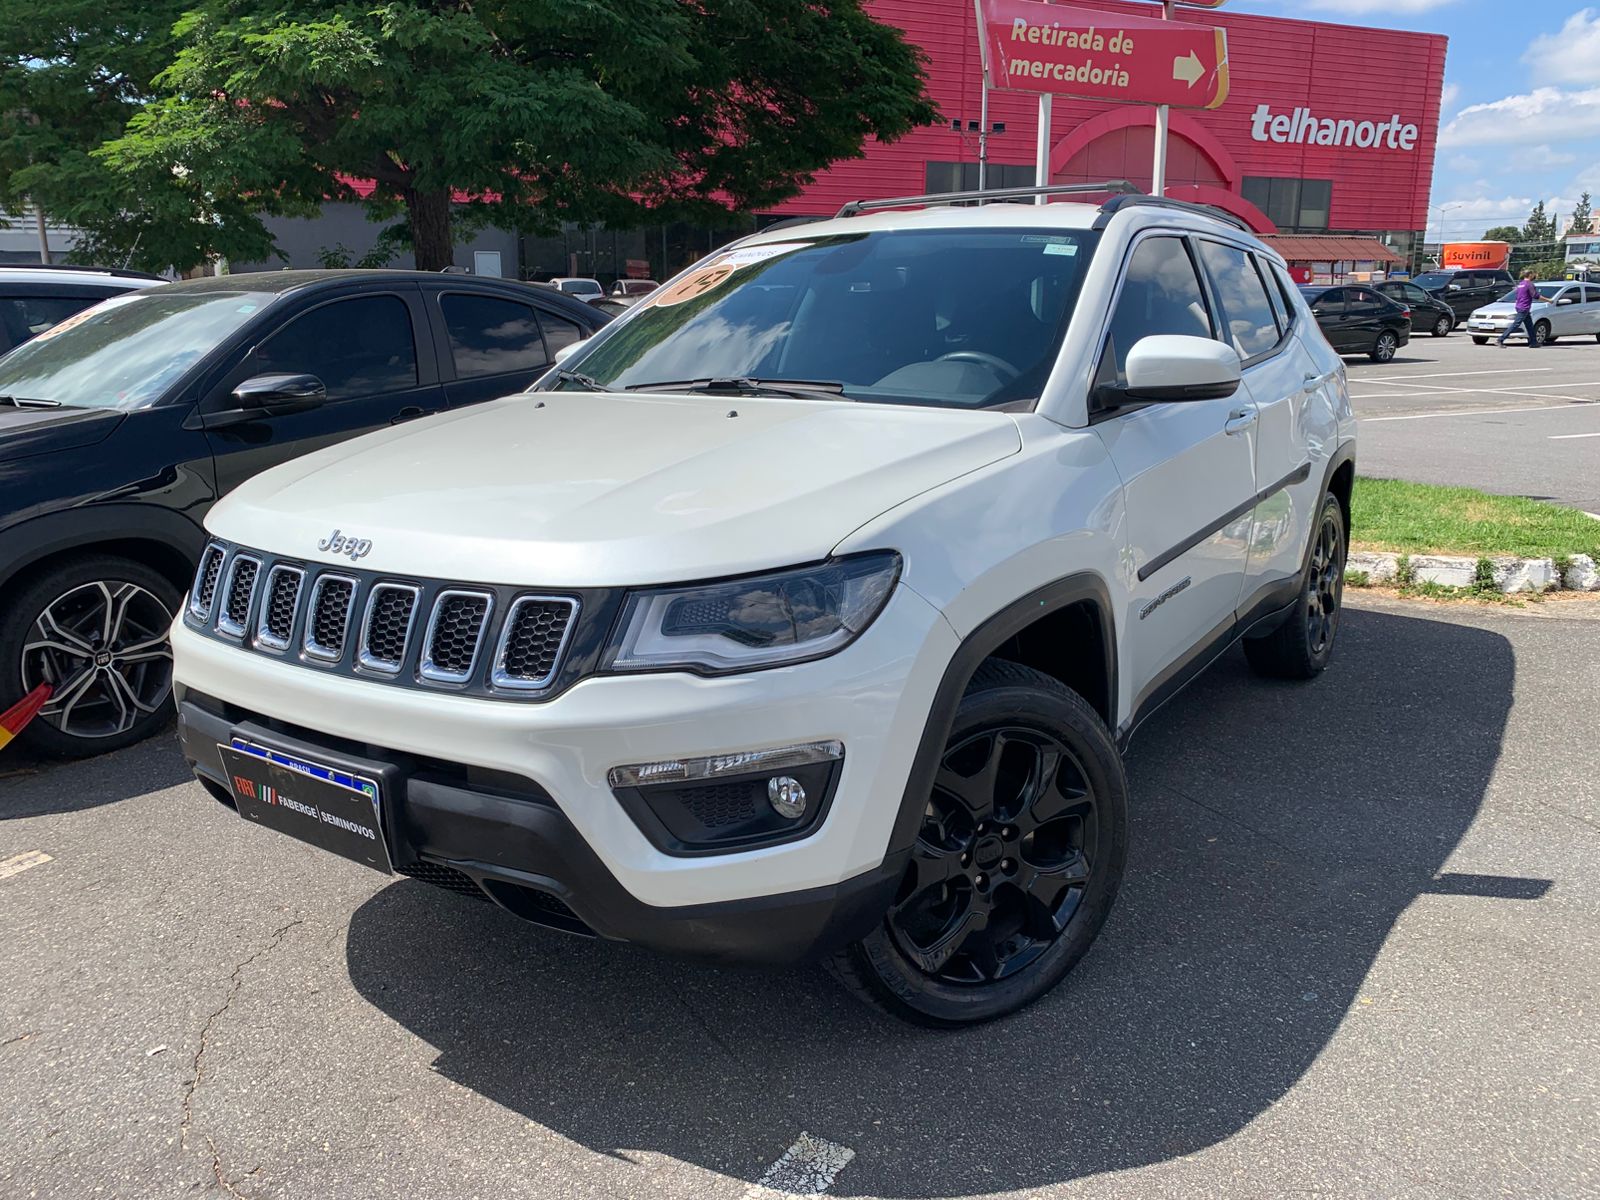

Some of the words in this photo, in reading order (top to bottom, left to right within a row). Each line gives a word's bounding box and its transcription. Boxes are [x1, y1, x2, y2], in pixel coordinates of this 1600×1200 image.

[1011, 17, 1104, 52] Retirada
[1107, 30, 1134, 55] de
[1009, 56, 1130, 88] mercadoria
[1250, 104, 1419, 151] telhanorte
[1451, 250, 1491, 261] Suvinil
[318, 528, 373, 562] Jeep
[233, 776, 256, 799] FIAT
[277, 795, 318, 819] FABERGE
[320, 810, 376, 840] SEMINOVOS
